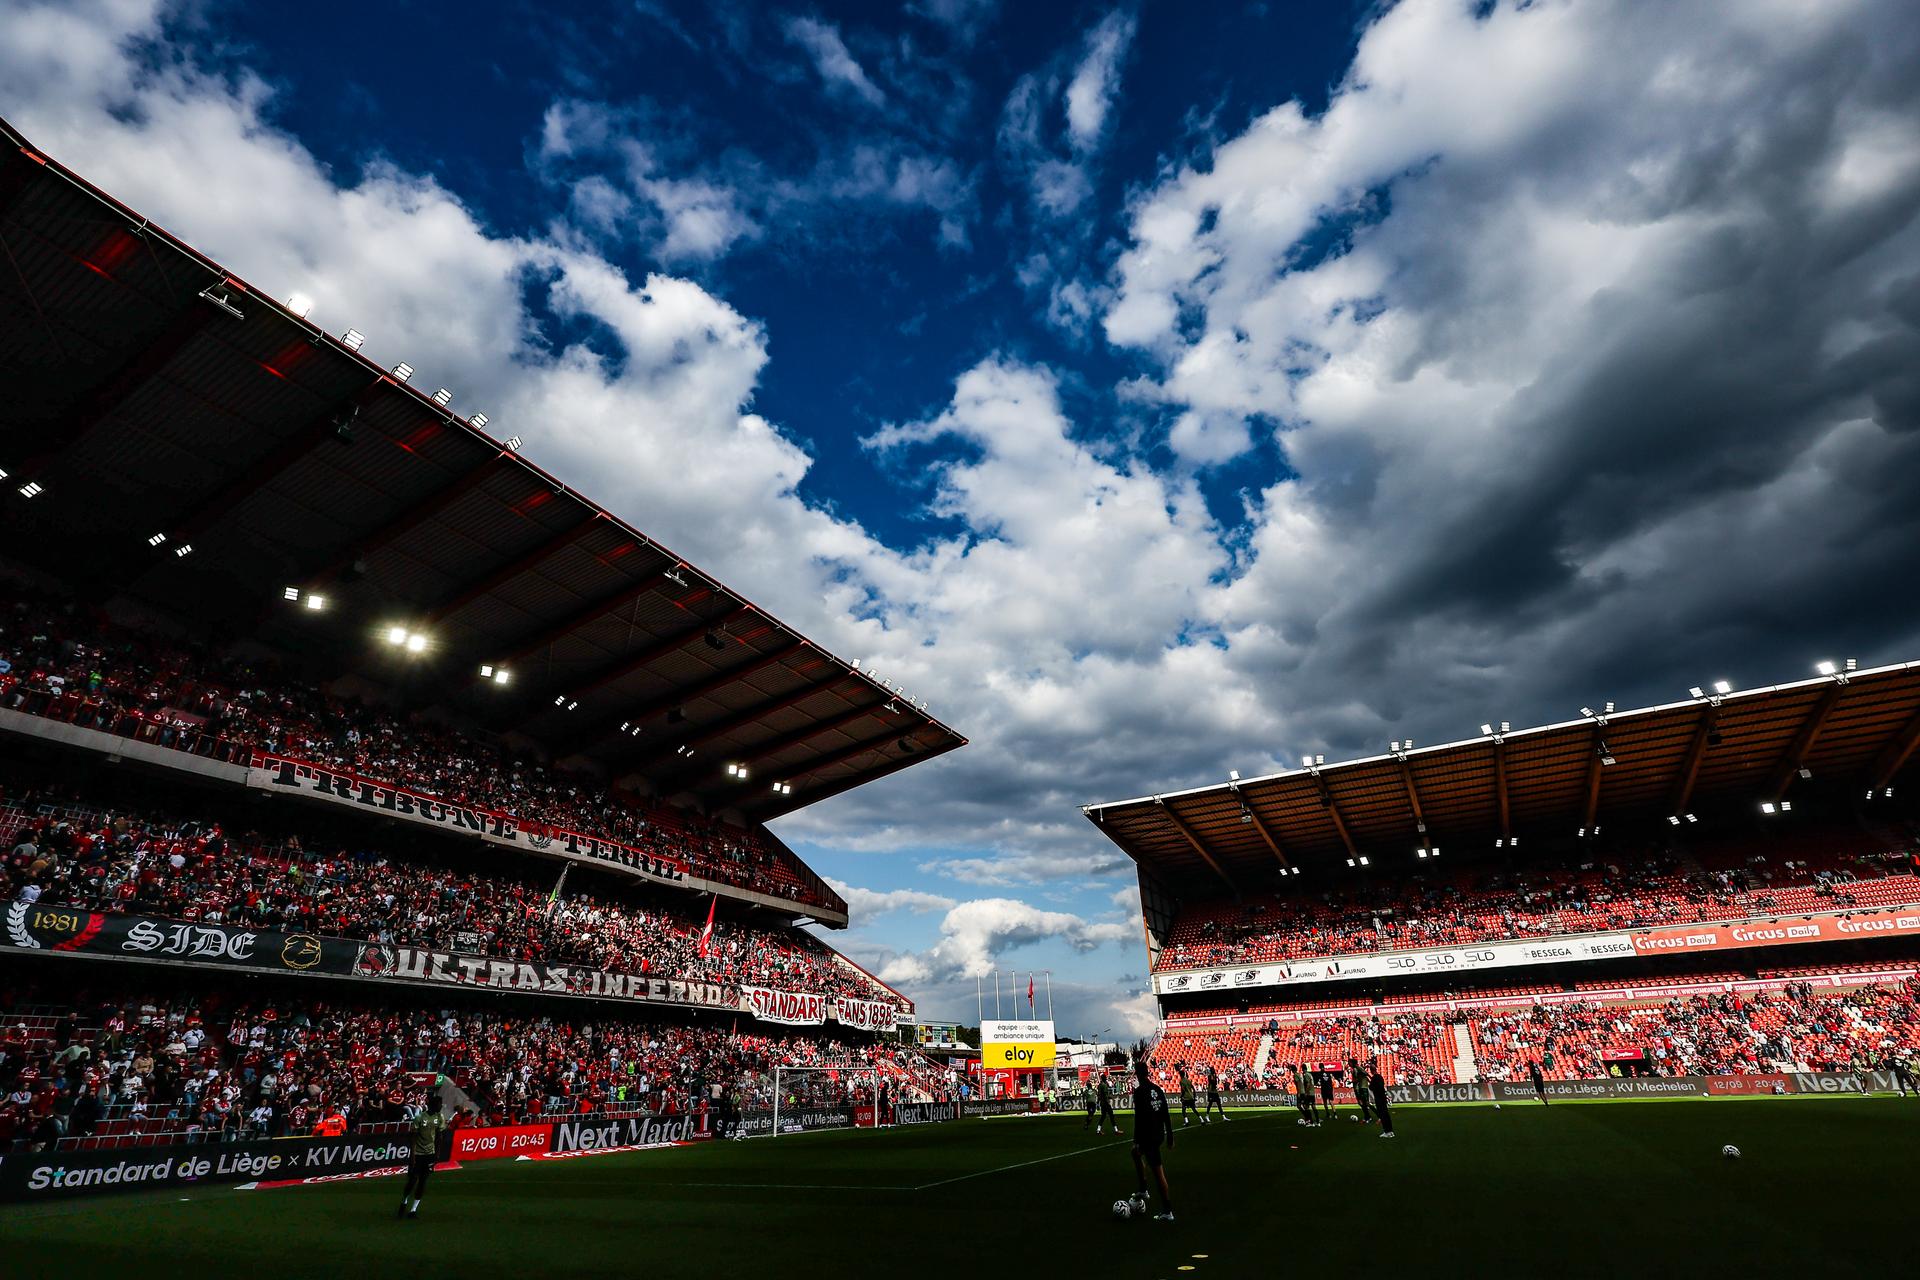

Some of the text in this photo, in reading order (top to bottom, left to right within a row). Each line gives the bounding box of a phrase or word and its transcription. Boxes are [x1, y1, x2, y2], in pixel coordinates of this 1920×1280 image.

[263, 756, 519, 841] TRIBUNE
[34, 912, 79, 933] 1981
[1837, 917, 1920, 933] Circus Dail
[121, 920, 259, 960] SIDE
[1732, 927, 1816, 942] Circus Daily
[1591, 943, 1634, 954] BESSEGA
[1635, 935, 1714, 950] Circus Daily
[1425, 953, 1455, 966] SLD
[1464, 950, 1495, 963] SLD
[1531, 947, 1572, 958] BESSEGA
[1387, 957, 1416, 969] SLD
[397, 949, 569, 993] ULTRAS
[837, 999, 867, 1027] FANS
[1025, 1032, 1045, 1040] unique
[1005, 1046, 1034, 1064] eloy
[1504, 1085, 1557, 1096] Standrd
[1558, 1085, 1572, 1095] de
[1573, 1084, 1605, 1096] Liège
[1616, 1083, 1634, 1092] KV
[1636, 1081, 1696, 1093] Mechelen
[1713, 1079, 1785, 1090] 12/09 20:45
[1236, 1094, 1248, 1102] KV
[1417, 1084, 1481, 1101] Match
[761, 1117, 771, 1129] de
[802, 1114, 813, 1125] KV
[895, 1104, 921, 1124] Next
[461, 1133, 545, 1152] 12/09 20:45
[558, 1118, 695, 1152] Next Match
[28, 1158, 173, 1190] Standard
[177, 1156, 211, 1178] de
[216, 1152, 282, 1176] Liège
[305, 1147, 340, 1167] KV
